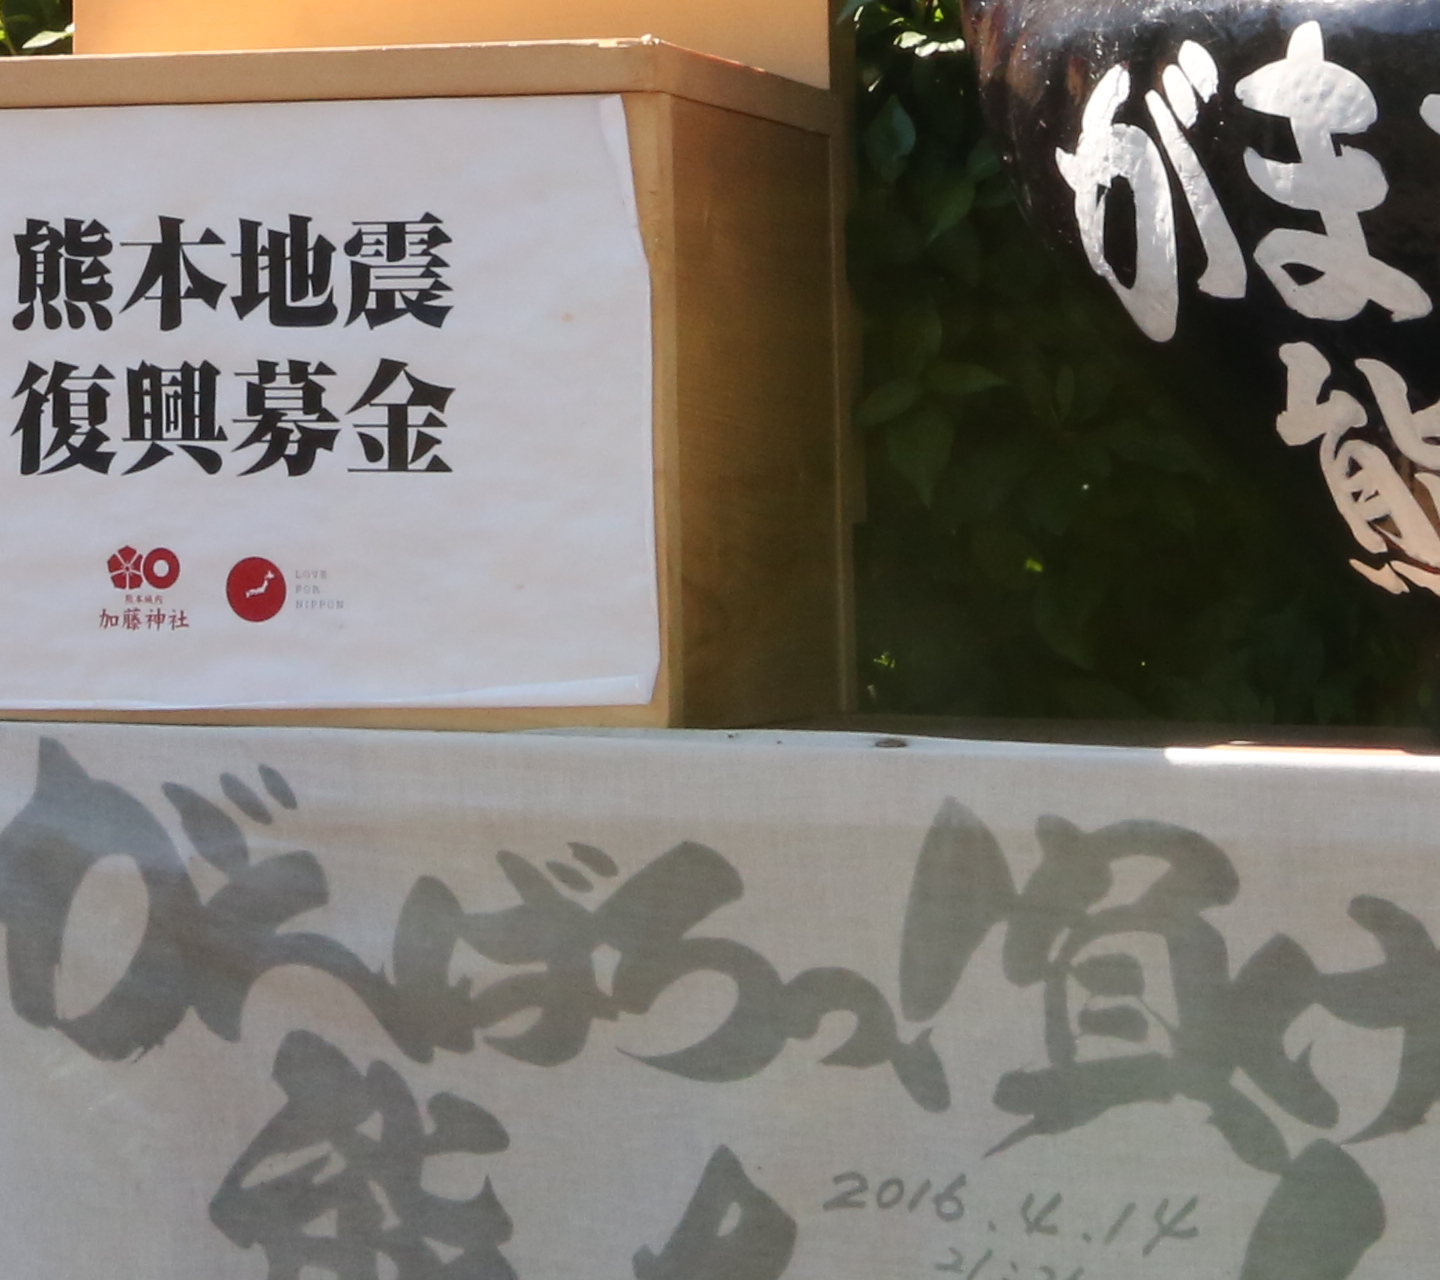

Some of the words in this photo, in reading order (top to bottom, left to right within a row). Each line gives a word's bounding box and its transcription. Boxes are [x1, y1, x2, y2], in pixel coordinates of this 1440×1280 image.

[11, 211, 455, 332] 熊本地震
[10, 358, 457, 477] 復興募金
[99, 607, 190, 631] 加藤神社
